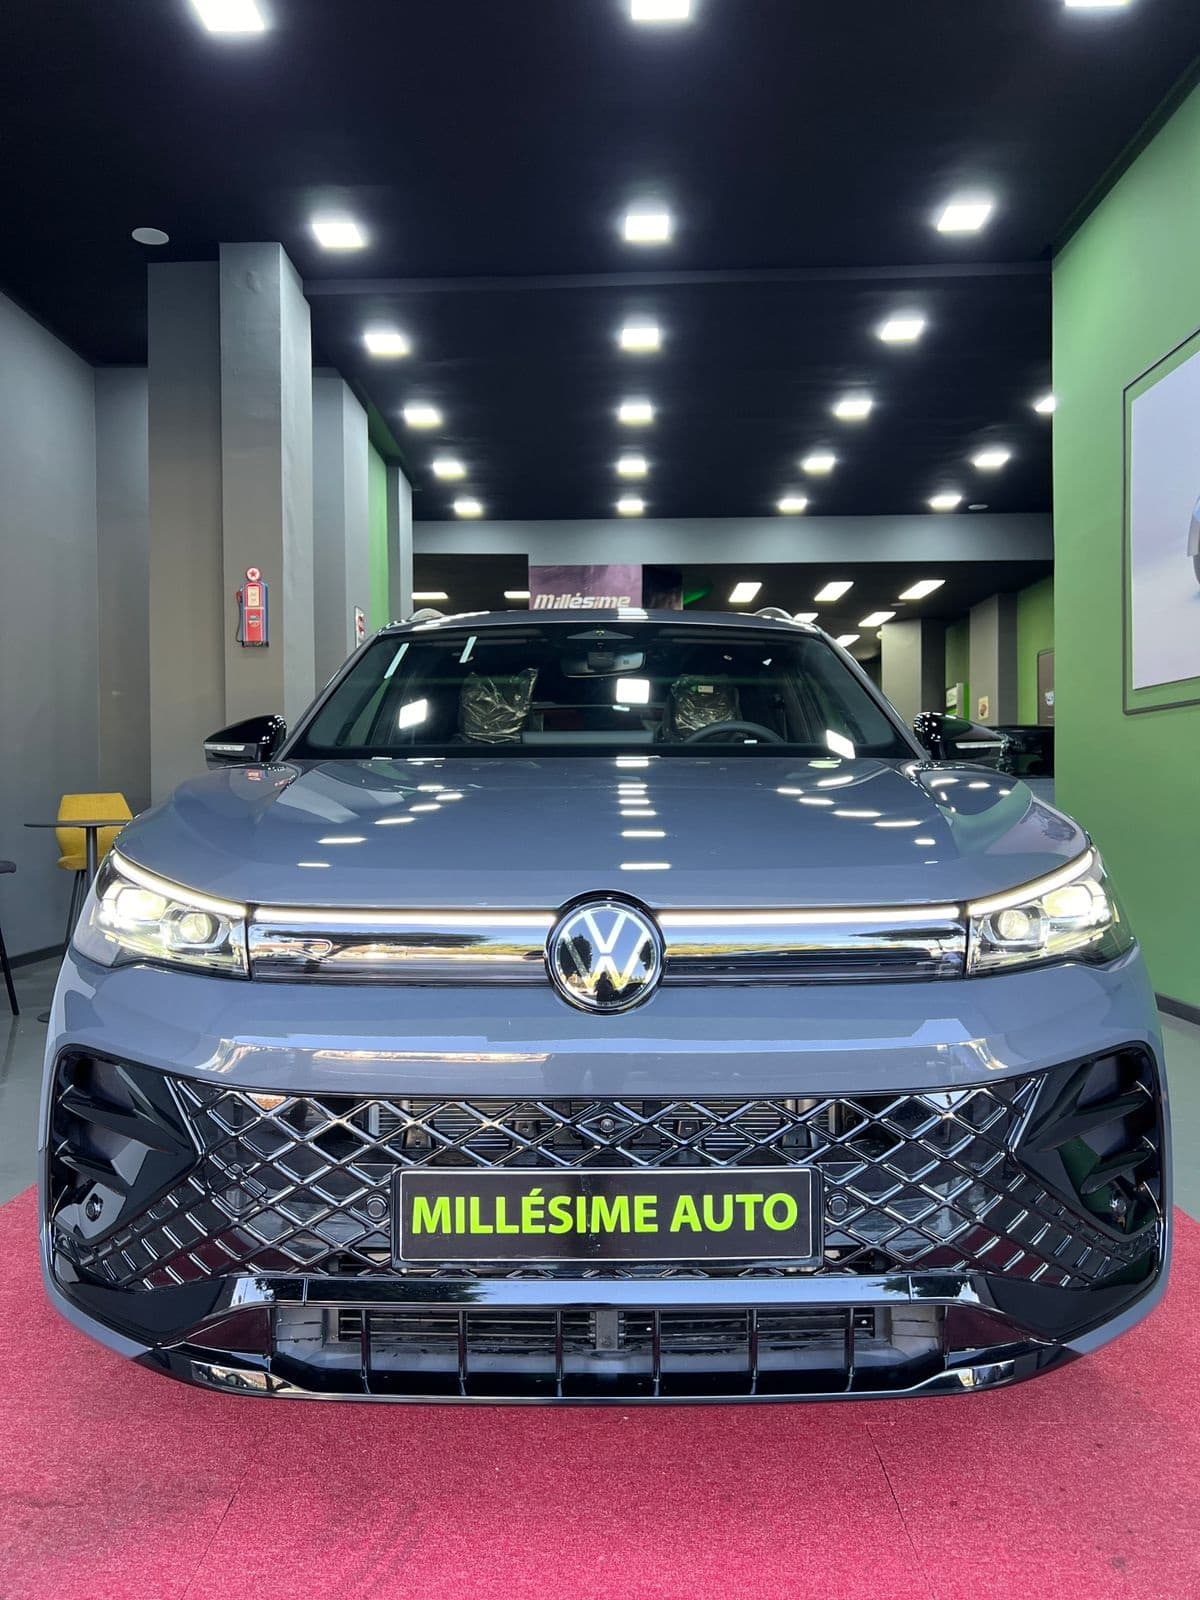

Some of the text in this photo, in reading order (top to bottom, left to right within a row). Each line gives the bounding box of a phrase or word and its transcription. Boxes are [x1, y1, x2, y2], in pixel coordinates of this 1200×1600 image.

[560, 907, 652, 994] VW
[412, 1188, 798, 1235] MILLÉSIME AUTO
